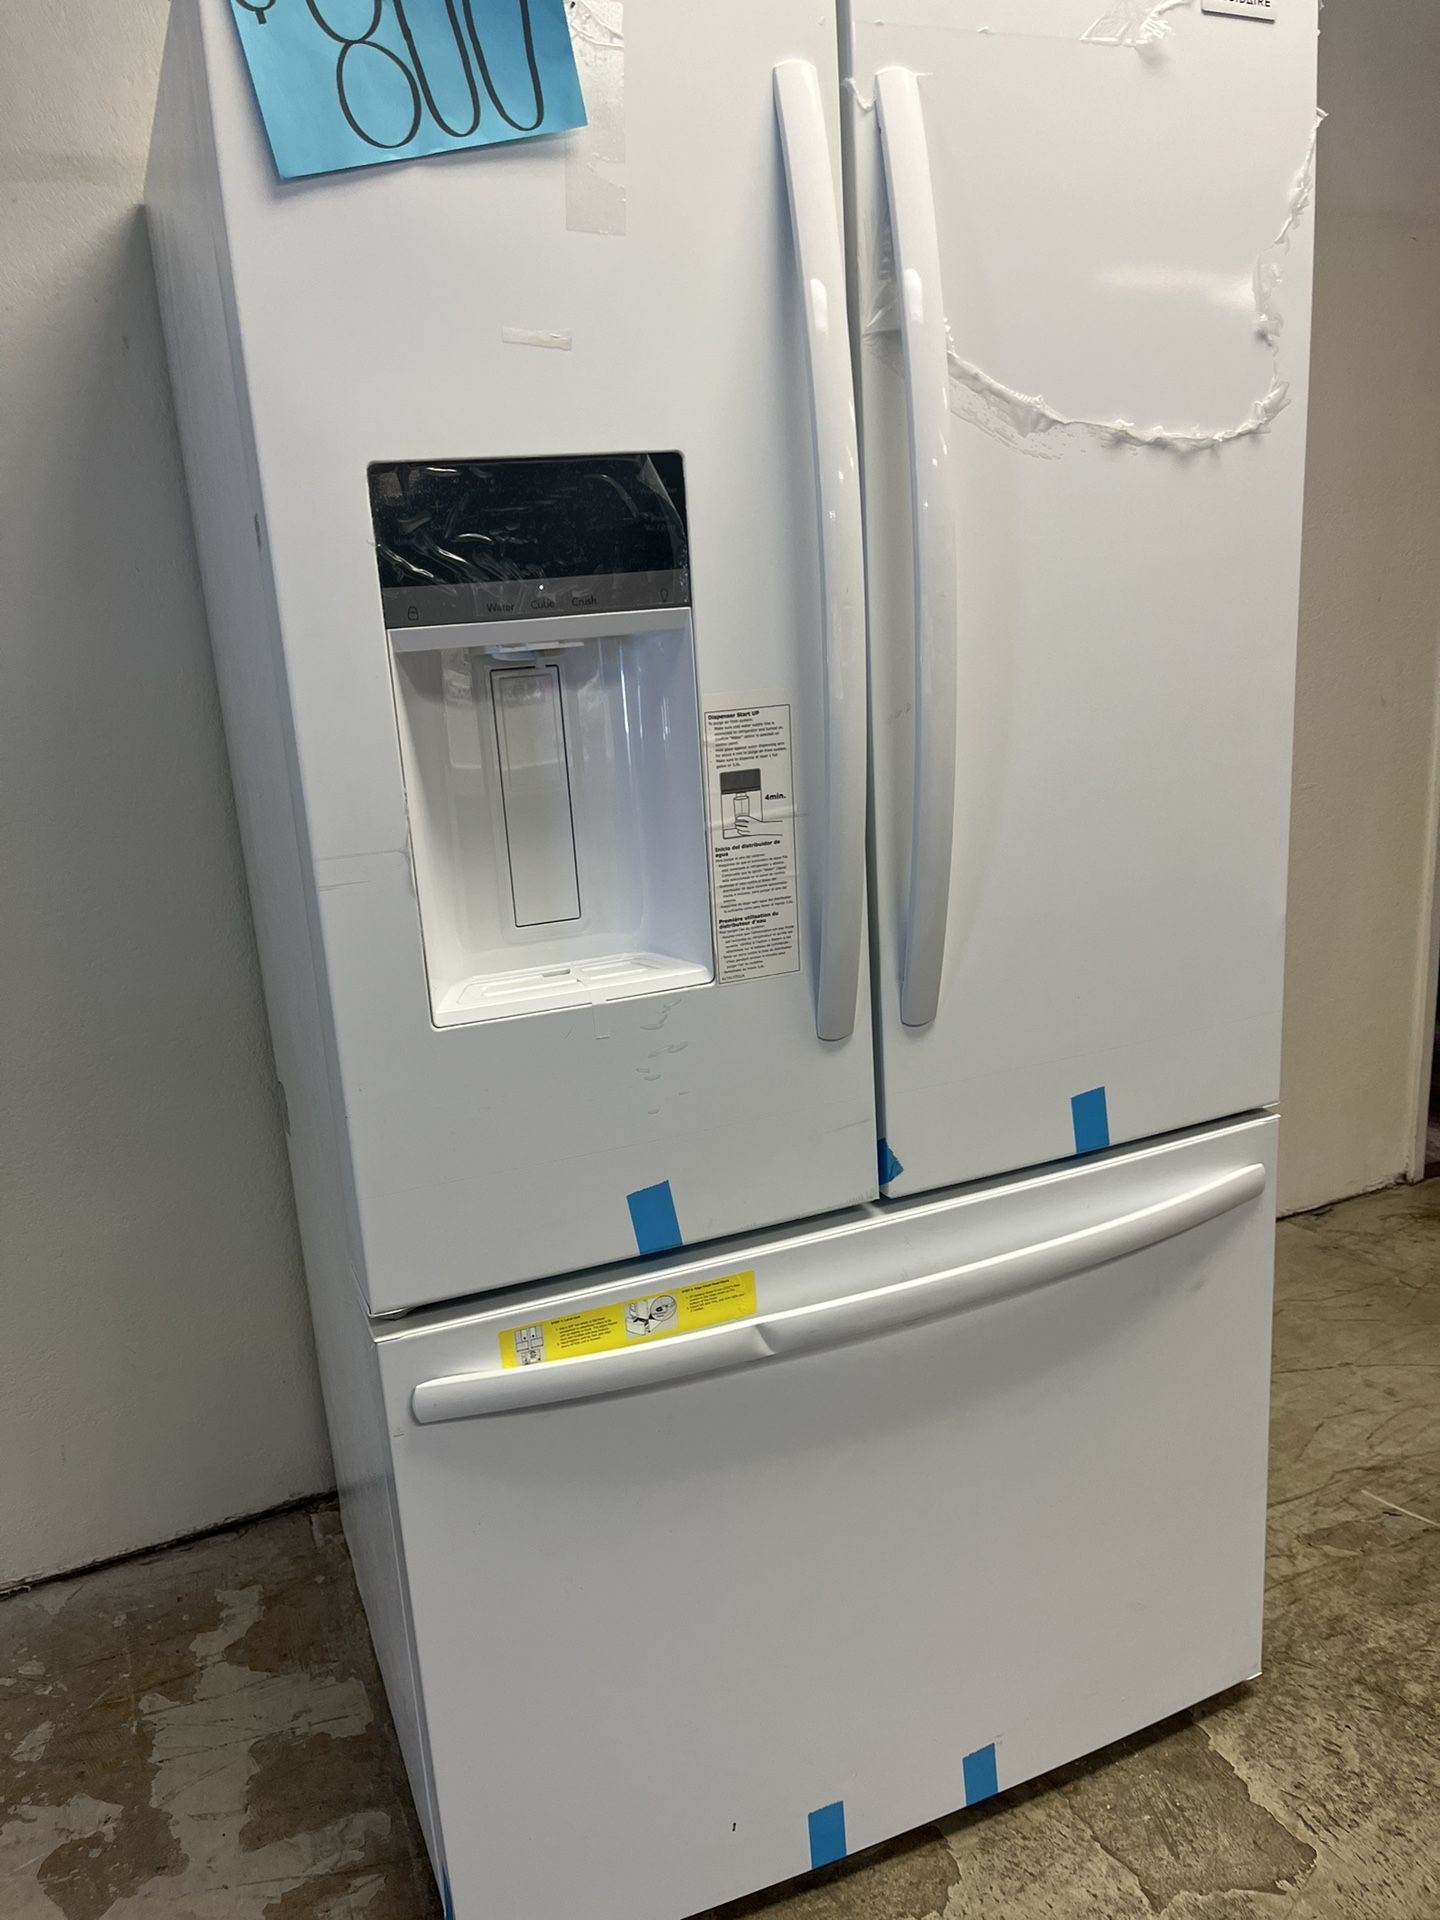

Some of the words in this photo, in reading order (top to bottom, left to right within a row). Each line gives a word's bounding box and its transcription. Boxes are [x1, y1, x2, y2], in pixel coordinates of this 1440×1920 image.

[235, 0, 545, 148] 800
[486, 600, 514, 613] Water
[764, 791, 786, 801] 4min.
